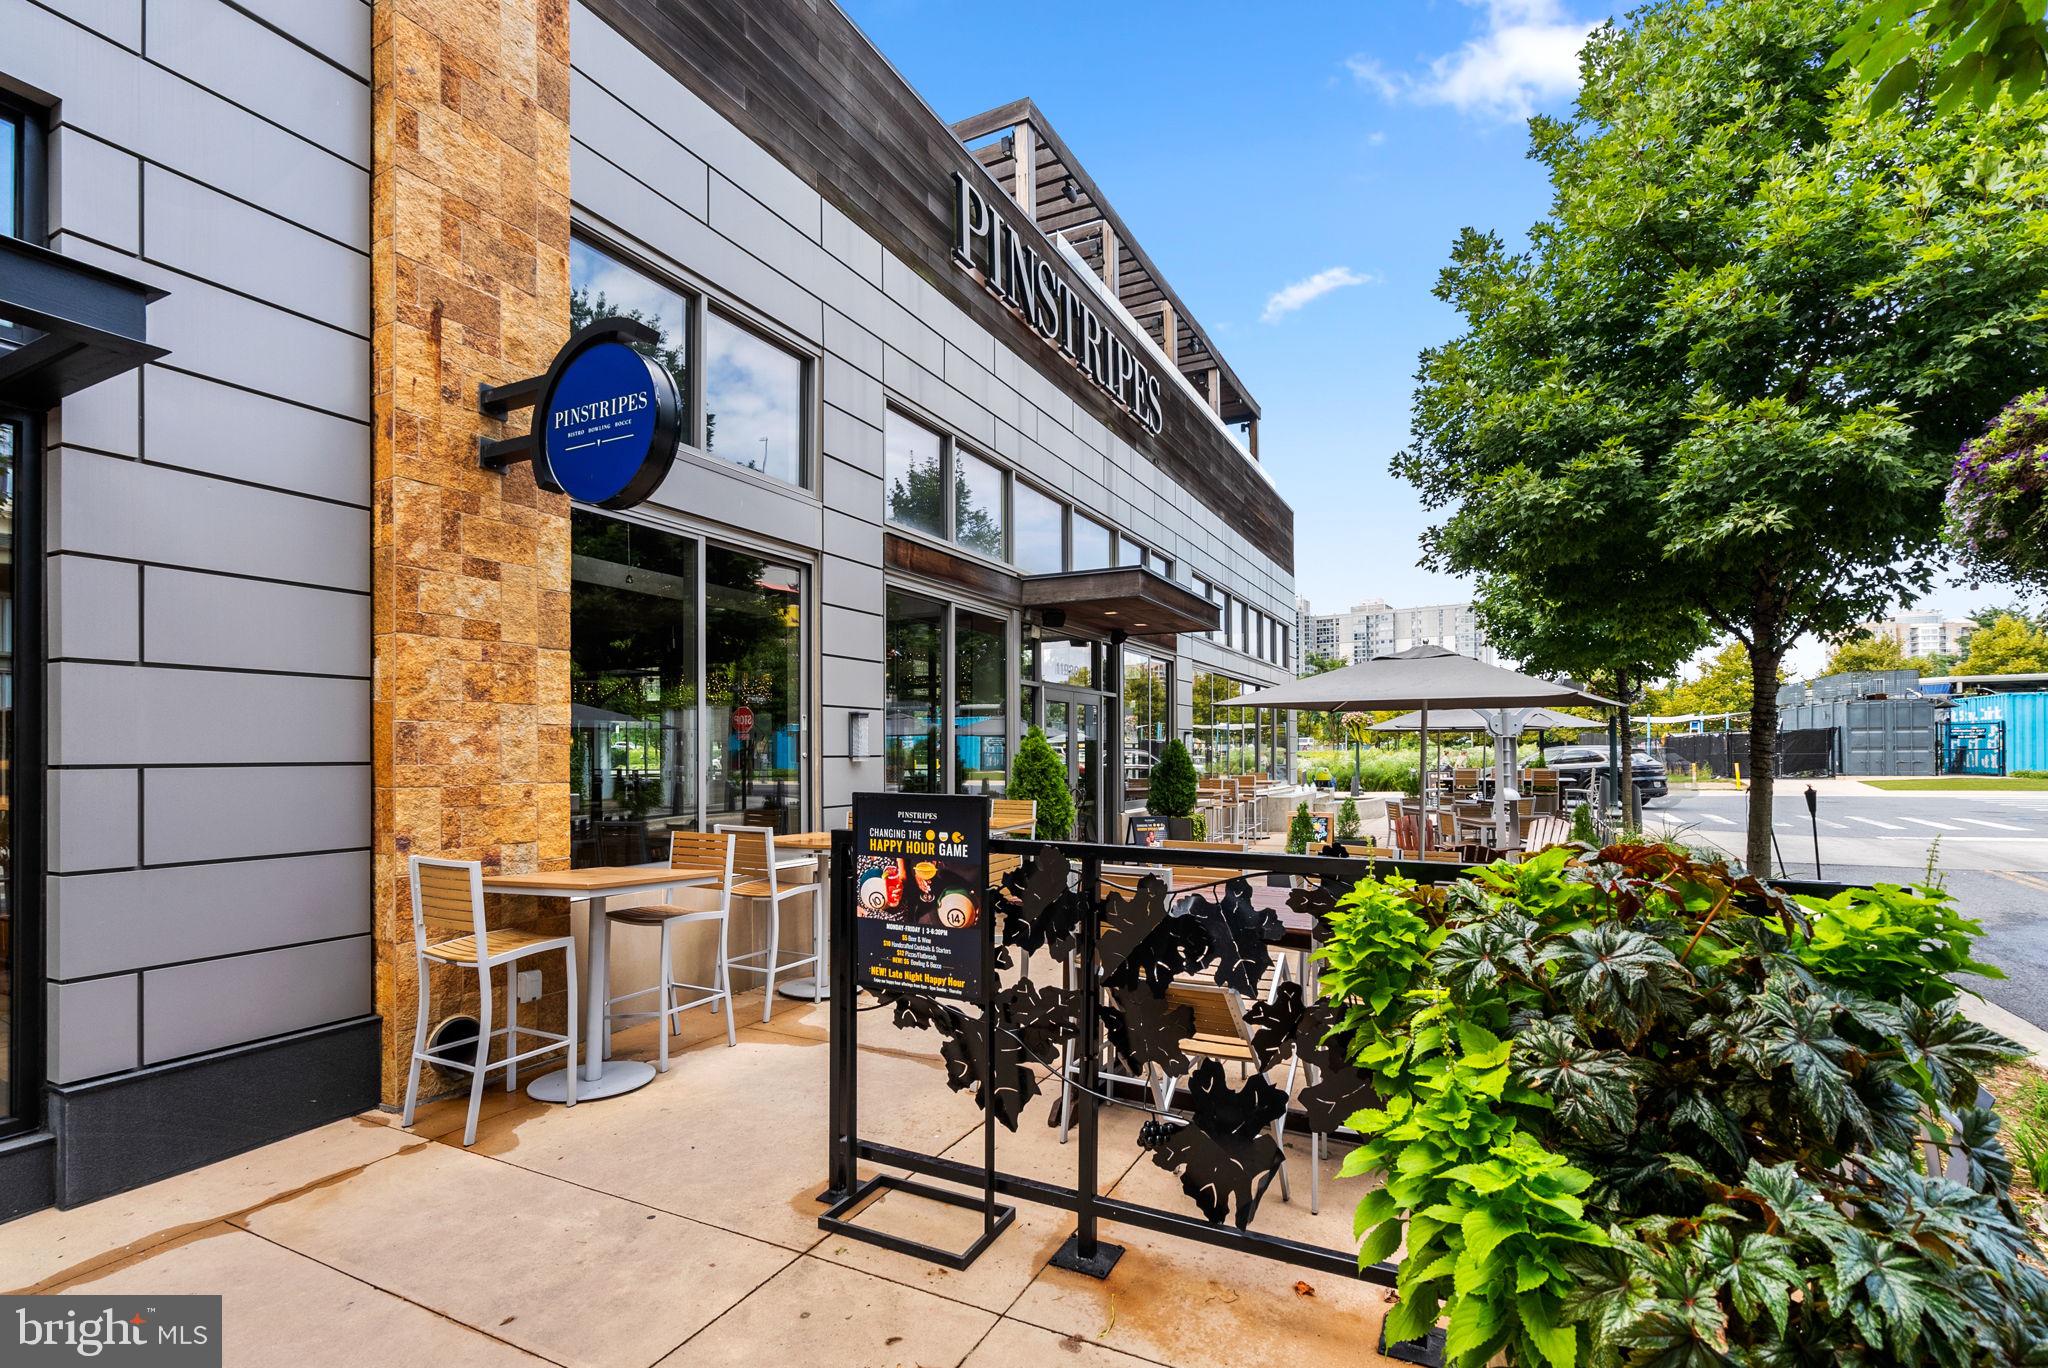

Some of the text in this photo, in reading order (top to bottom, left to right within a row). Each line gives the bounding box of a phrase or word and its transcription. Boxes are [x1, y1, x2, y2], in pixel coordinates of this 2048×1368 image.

[951, 171, 1163, 437] PINSTRIPES
[554, 391, 648, 429] PINSTRIPES
[567, 418, 632, 438] BISTRO BOWLING BOCCE
[897, 811, 938, 820] PINSTRIPES
[869, 827, 922, 840] CHANGING THE
[869, 838, 968, 858] HAPPY HOUR GAME
[951, 914, 961, 924] 14
[870, 966, 966, 988] NEW! Late Night Happy Hour
